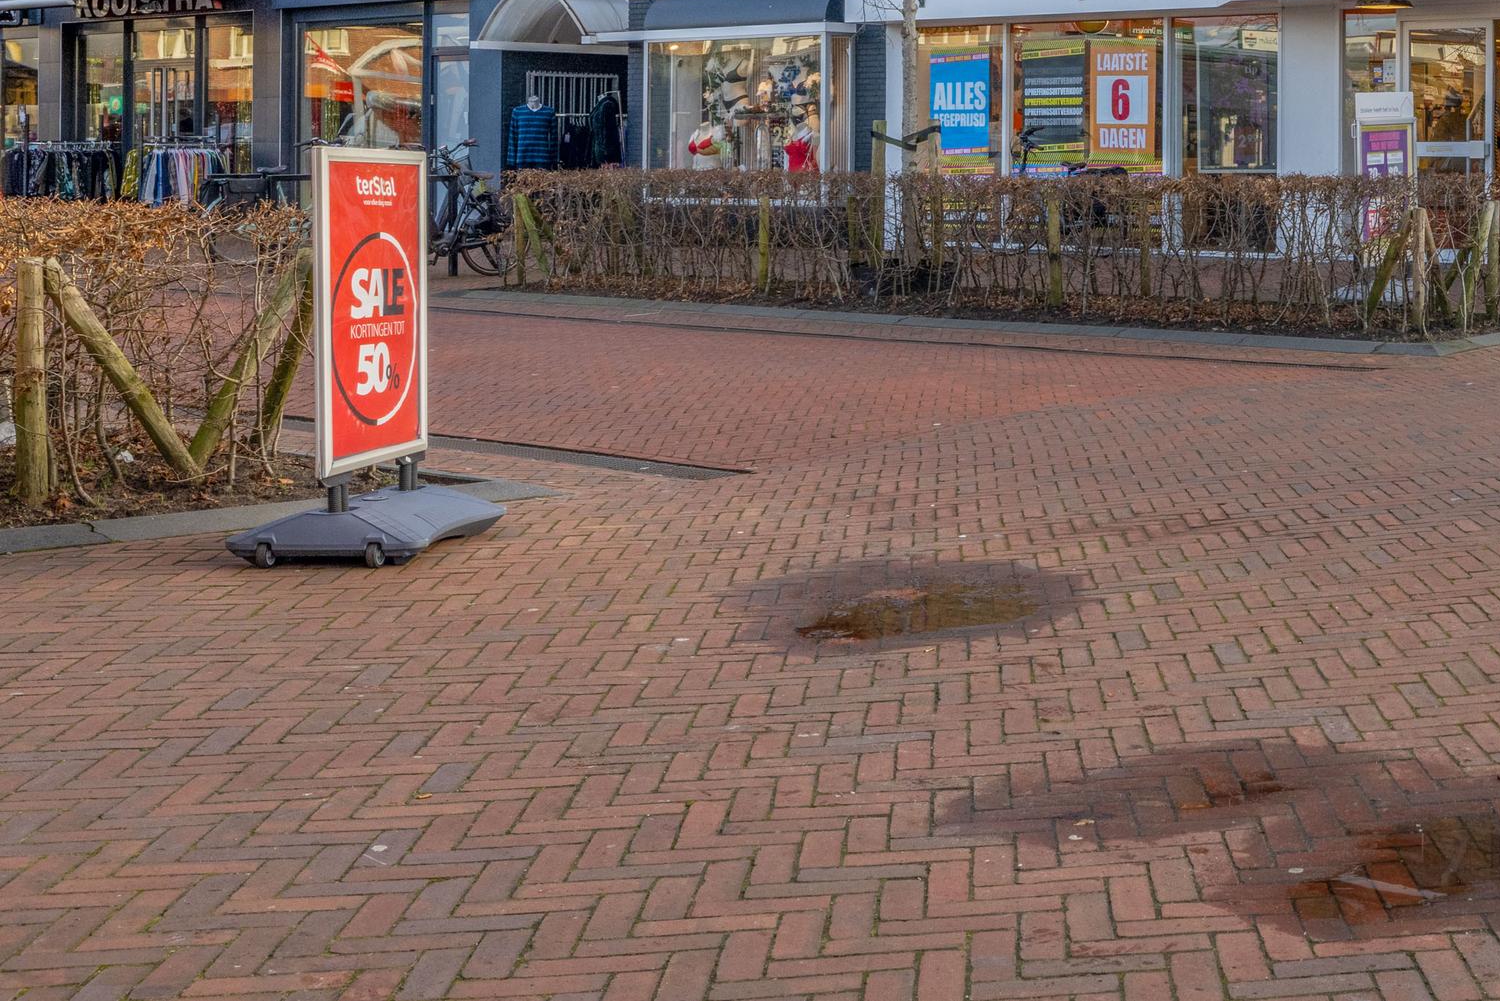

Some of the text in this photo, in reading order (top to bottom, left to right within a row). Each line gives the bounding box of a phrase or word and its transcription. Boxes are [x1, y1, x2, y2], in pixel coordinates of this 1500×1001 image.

[1096, 52, 1148, 72] LAATSTE
[933, 81, 986, 111] ALLES
[1111, 78, 1130, 121] 6
[1099, 127, 1147, 149] DAGEN
[355, 176, 397, 197] terStal
[351, 268, 404, 319] SALE
[350, 320, 406, 339] KORTINGEN TOT
[356, 341, 400, 396] 50%
